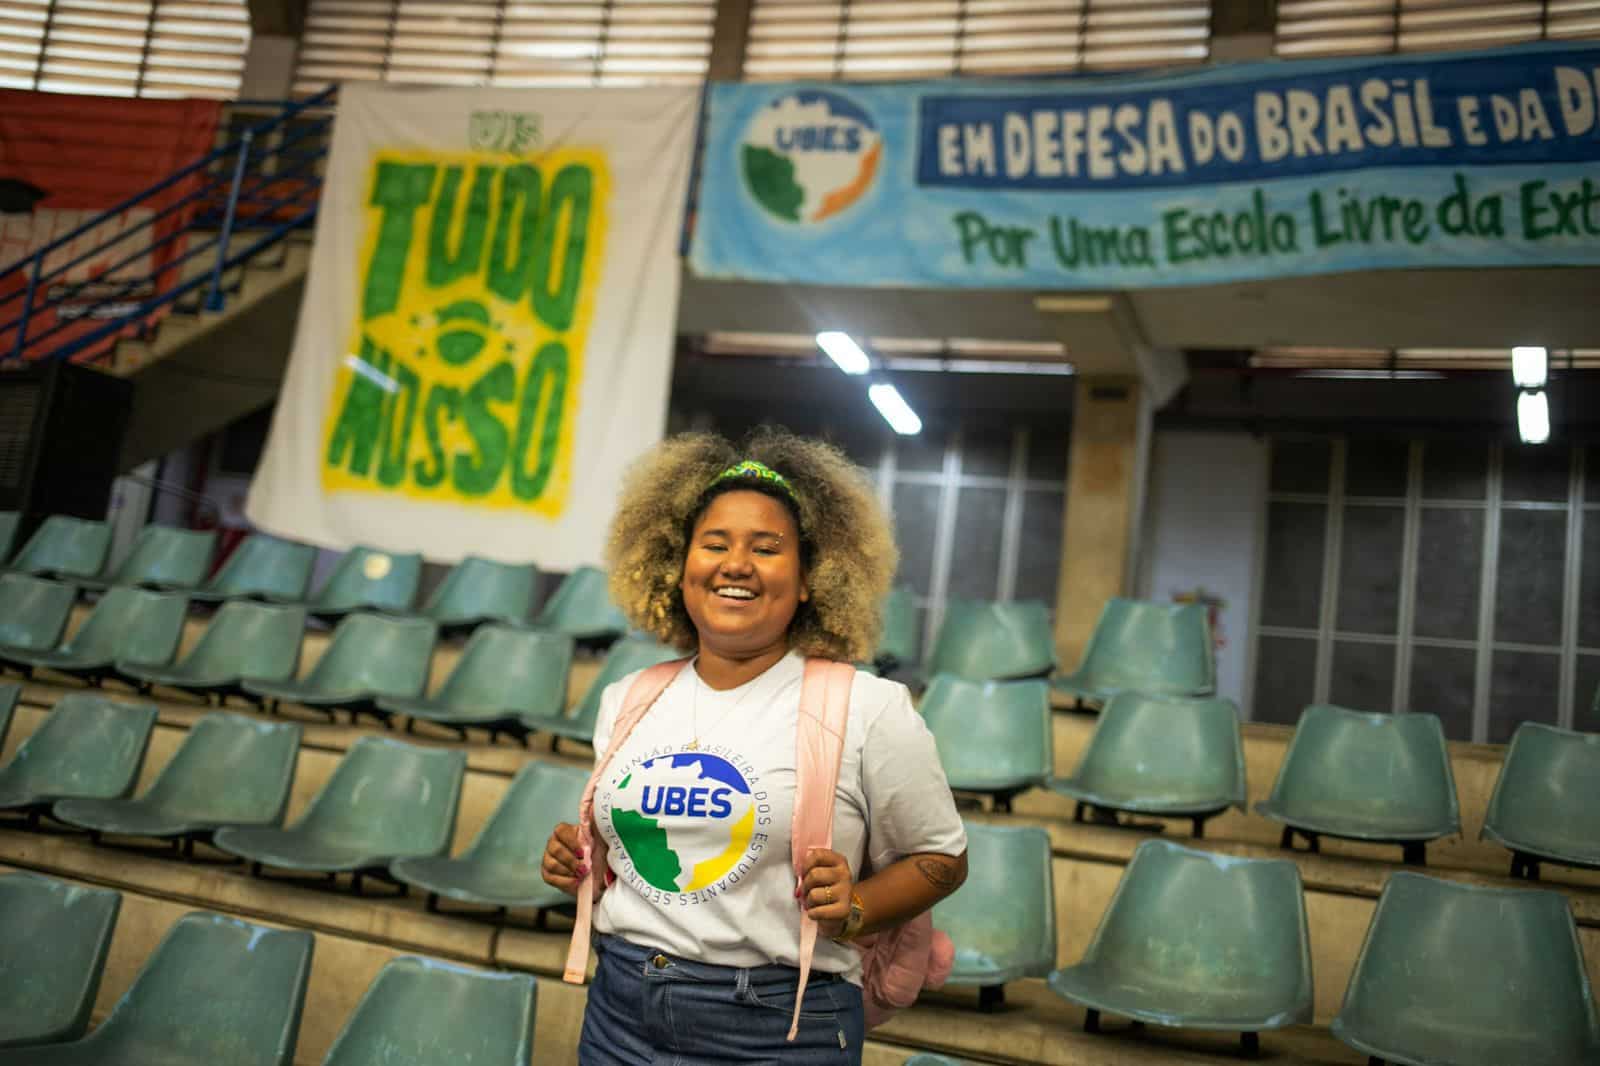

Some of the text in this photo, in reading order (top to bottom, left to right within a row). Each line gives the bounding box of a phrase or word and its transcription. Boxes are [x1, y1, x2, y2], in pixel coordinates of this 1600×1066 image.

[775, 126, 863, 152] UBES
[938, 124, 996, 177] EM
[1003, 99, 1186, 180] DEFESA
[1188, 111, 1245, 164] DO
[1457, 96, 1488, 146] E
[1491, 88, 1553, 142] DA
[1554, 66, 1600, 136] D
[364, 161, 593, 334] TUDO
[952, 210, 1037, 267] Por
[1049, 215, 1156, 269] Uma
[1162, 187, 1298, 264] Escola
[1309, 188, 1430, 248] Livre
[1437, 172, 1505, 238] da
[327, 334, 569, 503] NOSSO
[641, 785, 733, 818] UBES
[680, 744, 760, 786] BASILEIRA
[600, 792, 671, 905] SECUNDARISTAS
[754, 791, 771, 826] DOS
[679, 832, 768, 906] ESTUDANTES
